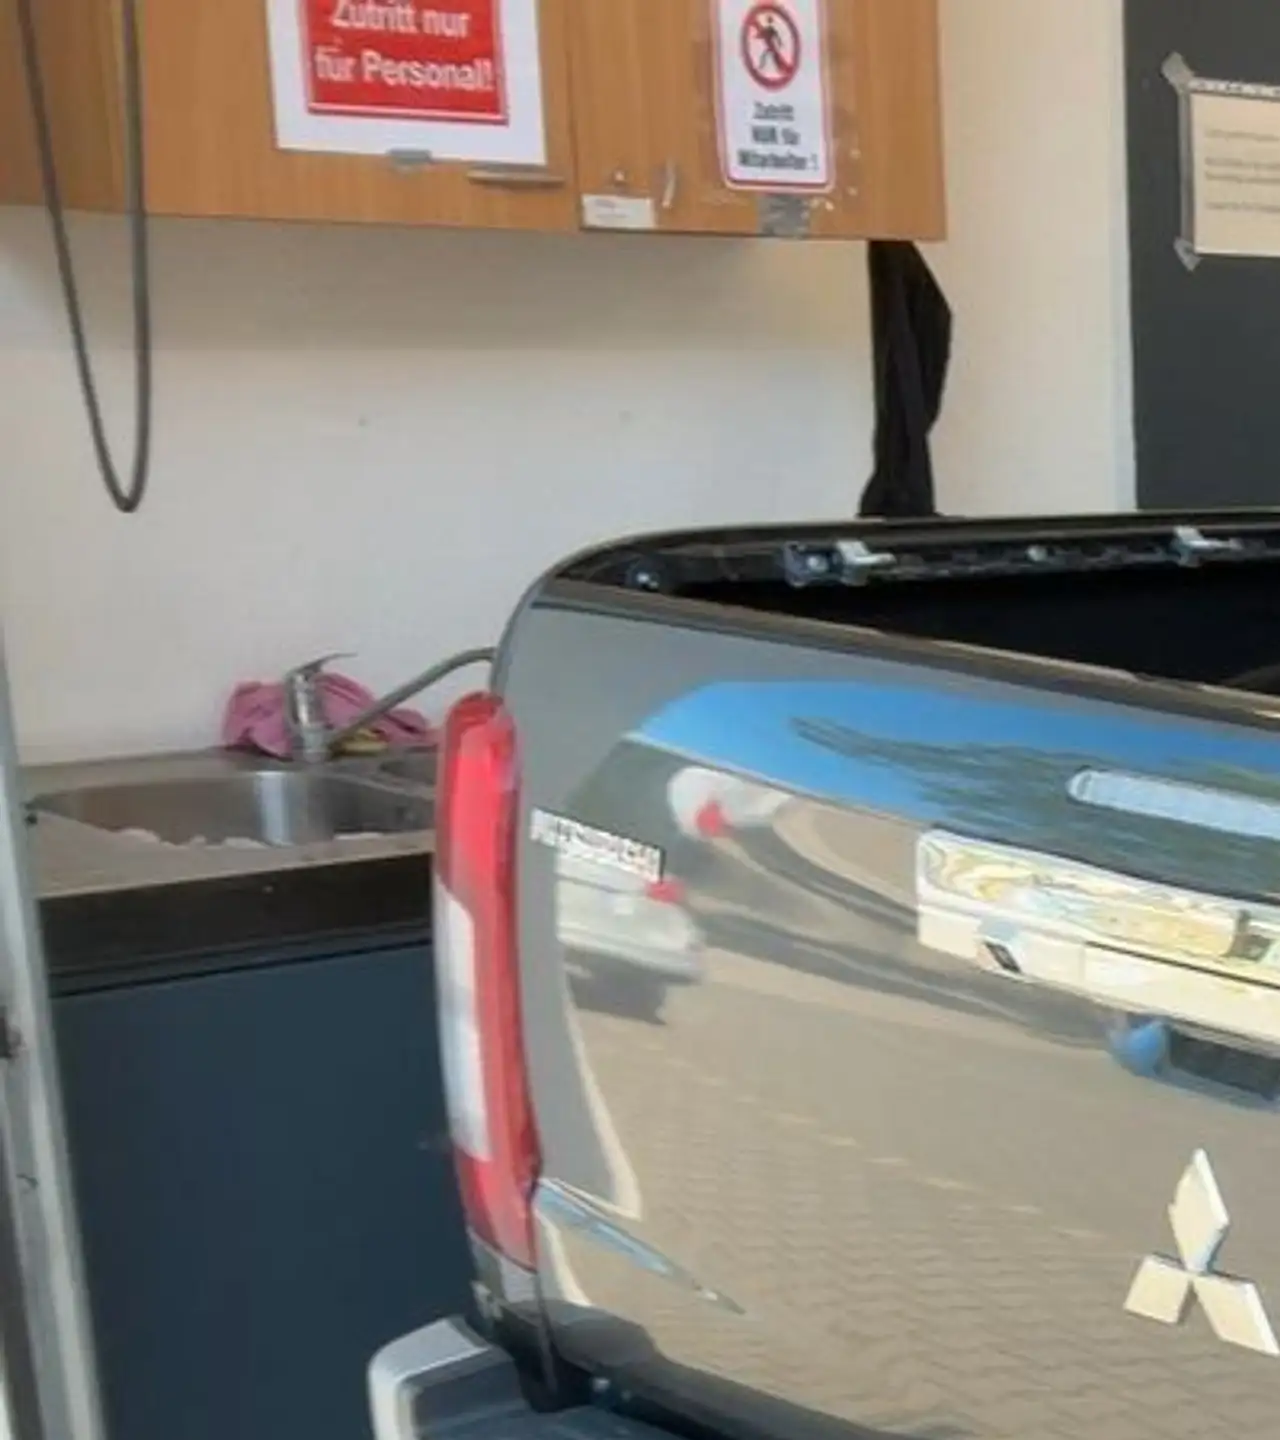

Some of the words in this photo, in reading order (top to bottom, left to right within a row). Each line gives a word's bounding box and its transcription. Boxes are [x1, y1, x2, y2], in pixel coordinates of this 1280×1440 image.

[332, 0, 417, 33] Zutritt
[422, 9, 471, 38] nur
[313, 37, 356, 82] für
[361, 48, 495, 91] Personal!
